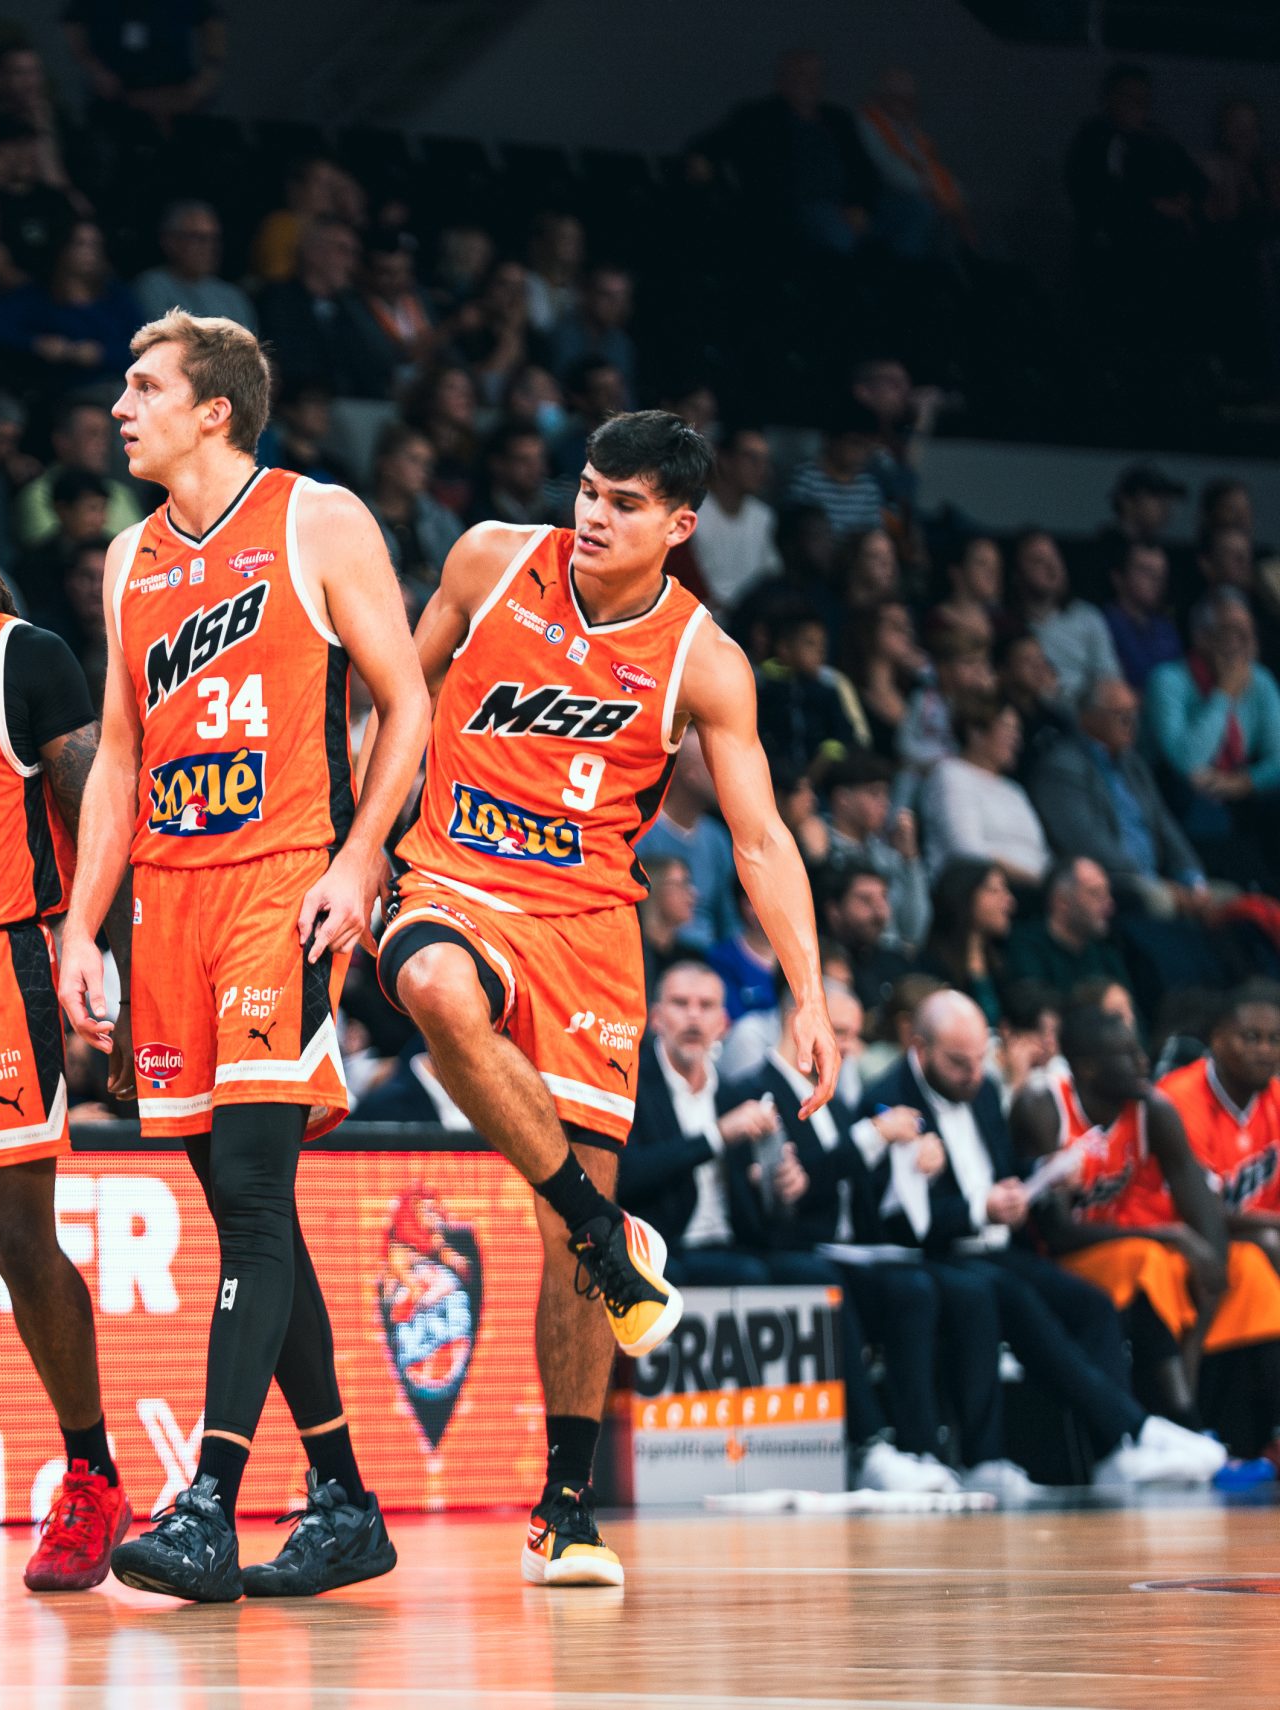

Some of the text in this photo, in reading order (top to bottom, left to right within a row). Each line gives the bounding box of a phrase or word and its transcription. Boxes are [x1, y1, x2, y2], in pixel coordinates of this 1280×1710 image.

[234, 551, 275, 569] Gaulois
[145, 579, 271, 720] MSB
[616, 664, 657, 689] Gaulois
[196, 673, 269, 740] 34
[461, 681, 643, 743] MSB
[152, 747, 258, 823] Loué
[561, 752, 607, 813] 9
[241, 1001, 276, 1019] Rapi
[598, 1017, 638, 1037] Sadrin
[599, 1030, 633, 1051] Rapin
[634, 1303, 827, 1397] GRAPH
